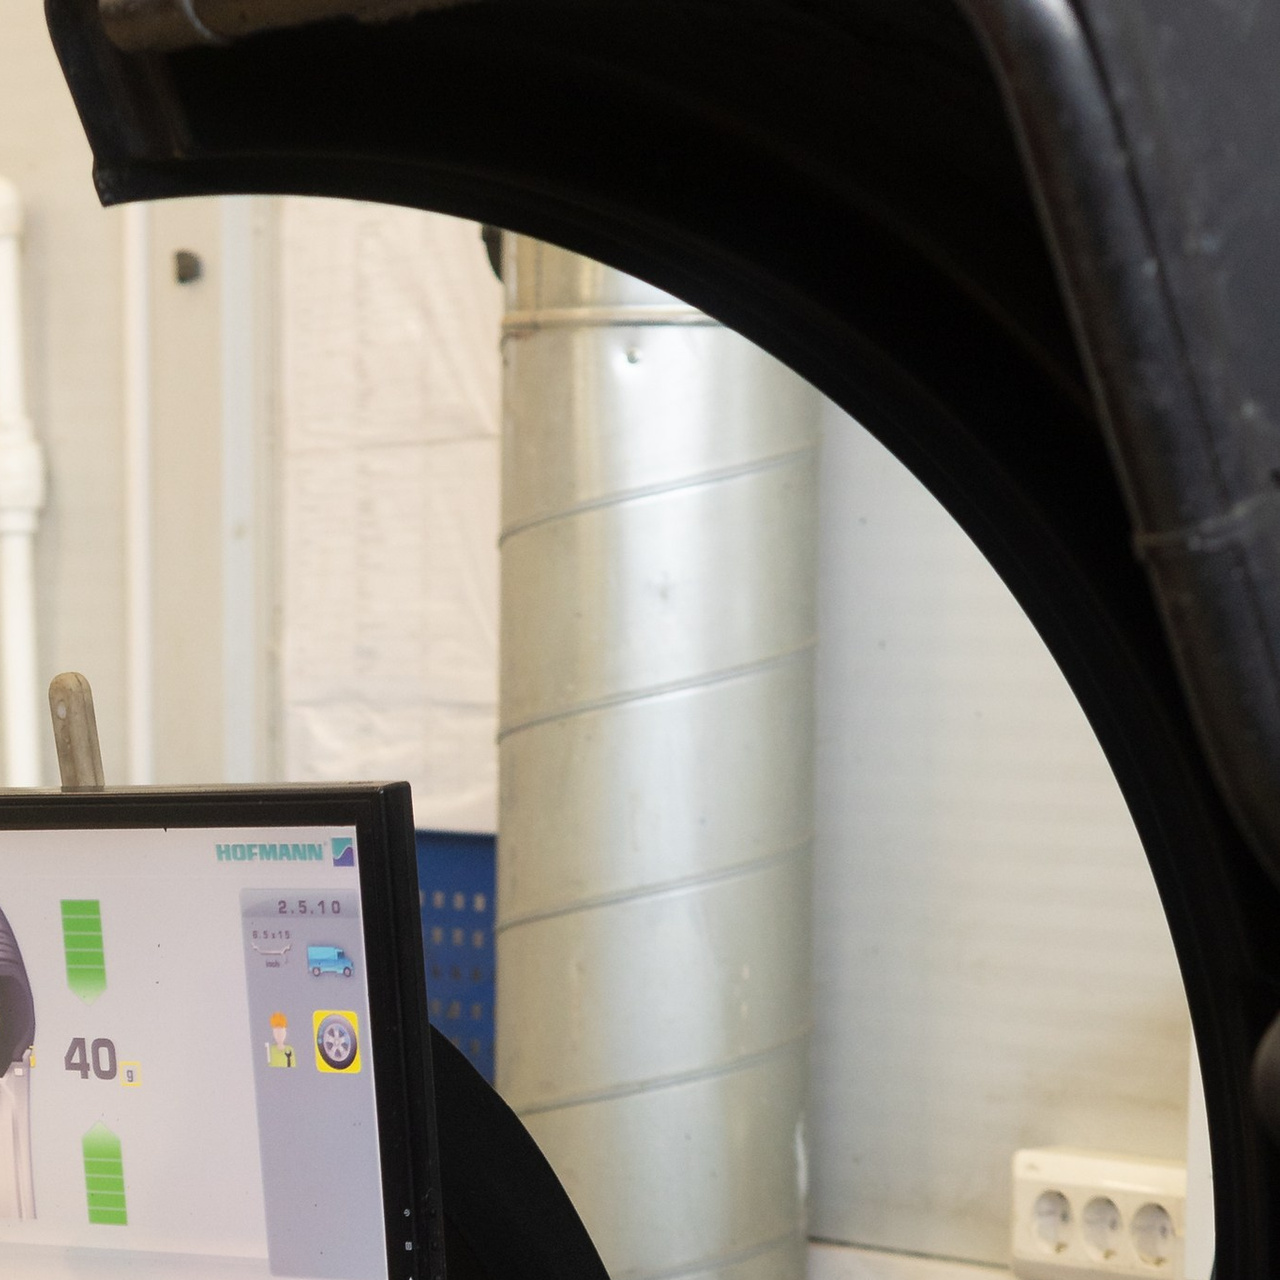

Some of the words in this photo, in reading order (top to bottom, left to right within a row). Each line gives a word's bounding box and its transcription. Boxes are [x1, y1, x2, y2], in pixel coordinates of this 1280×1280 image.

[215, 843, 323, 861] HOFMANN
[277, 900, 341, 914] 2.5.10
[64, 1037, 118, 1080] 40
